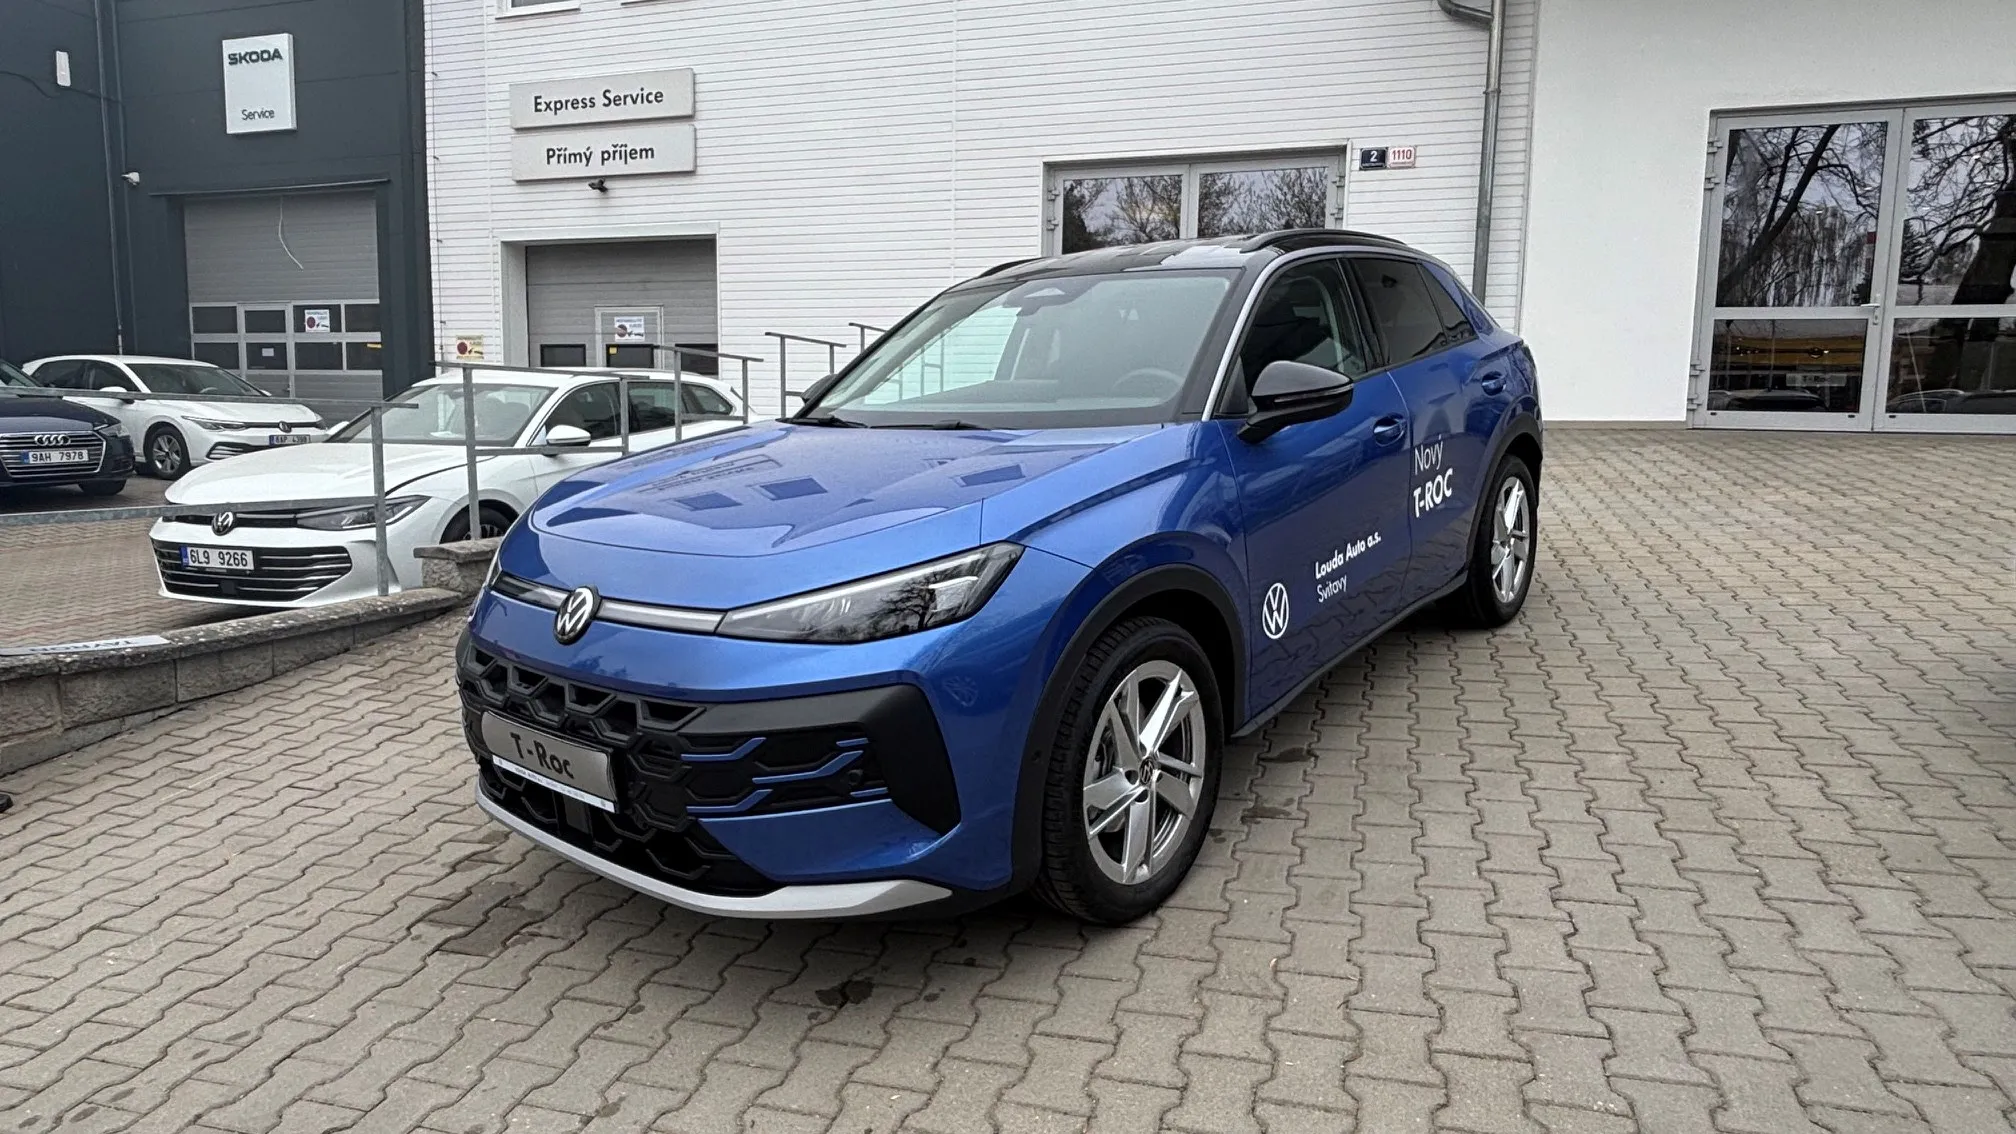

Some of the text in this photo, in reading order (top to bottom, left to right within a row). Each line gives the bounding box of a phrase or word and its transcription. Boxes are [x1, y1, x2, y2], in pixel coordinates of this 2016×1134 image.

[228, 48, 283, 66] SKODA
[534, 87, 664, 115] Express Service
[241, 107, 275, 121] Service
[546, 143, 656, 167] Přímý příjem
[1370, 150, 1378, 162] 2
[1391, 149, 1412, 161] 1110
[31, 451, 84, 463] 9AH 7978
[1414, 434, 1444, 475] Nový
[1413, 467, 1453, 518] T-ROC
[189, 549, 248, 567] 6L9 9266
[1315, 531, 1382, 580] Louda Auto a.s.
[1317, 575, 1347, 603] Svitavy
[510, 731, 575, 779] T-Roc
